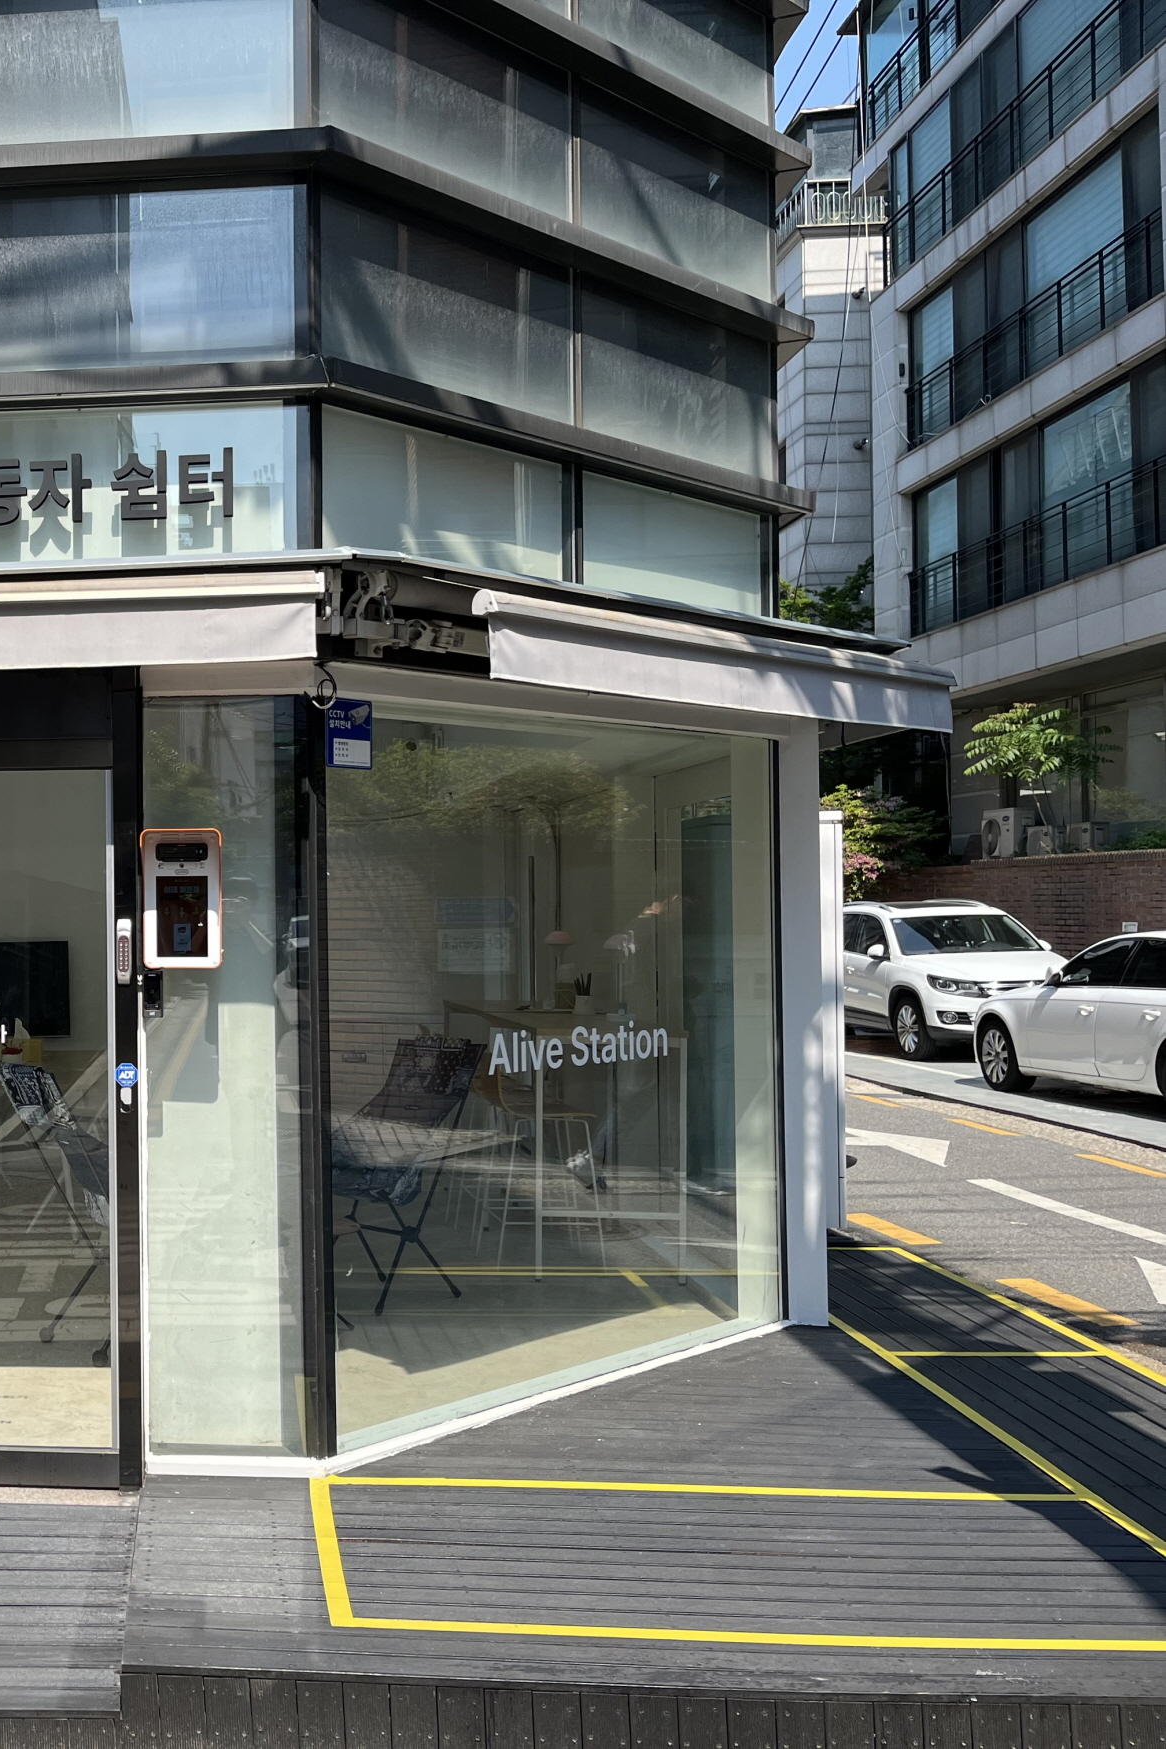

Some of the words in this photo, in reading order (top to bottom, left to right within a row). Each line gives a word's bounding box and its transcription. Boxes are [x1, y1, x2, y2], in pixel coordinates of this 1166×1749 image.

[110, 446, 235, 521] 쉼터
[328, 709, 345, 719] CCTV
[488, 1029, 564, 1076] Alive
[571, 1020, 669, 1067] Station
[118, 1070, 135, 1080] ADT
